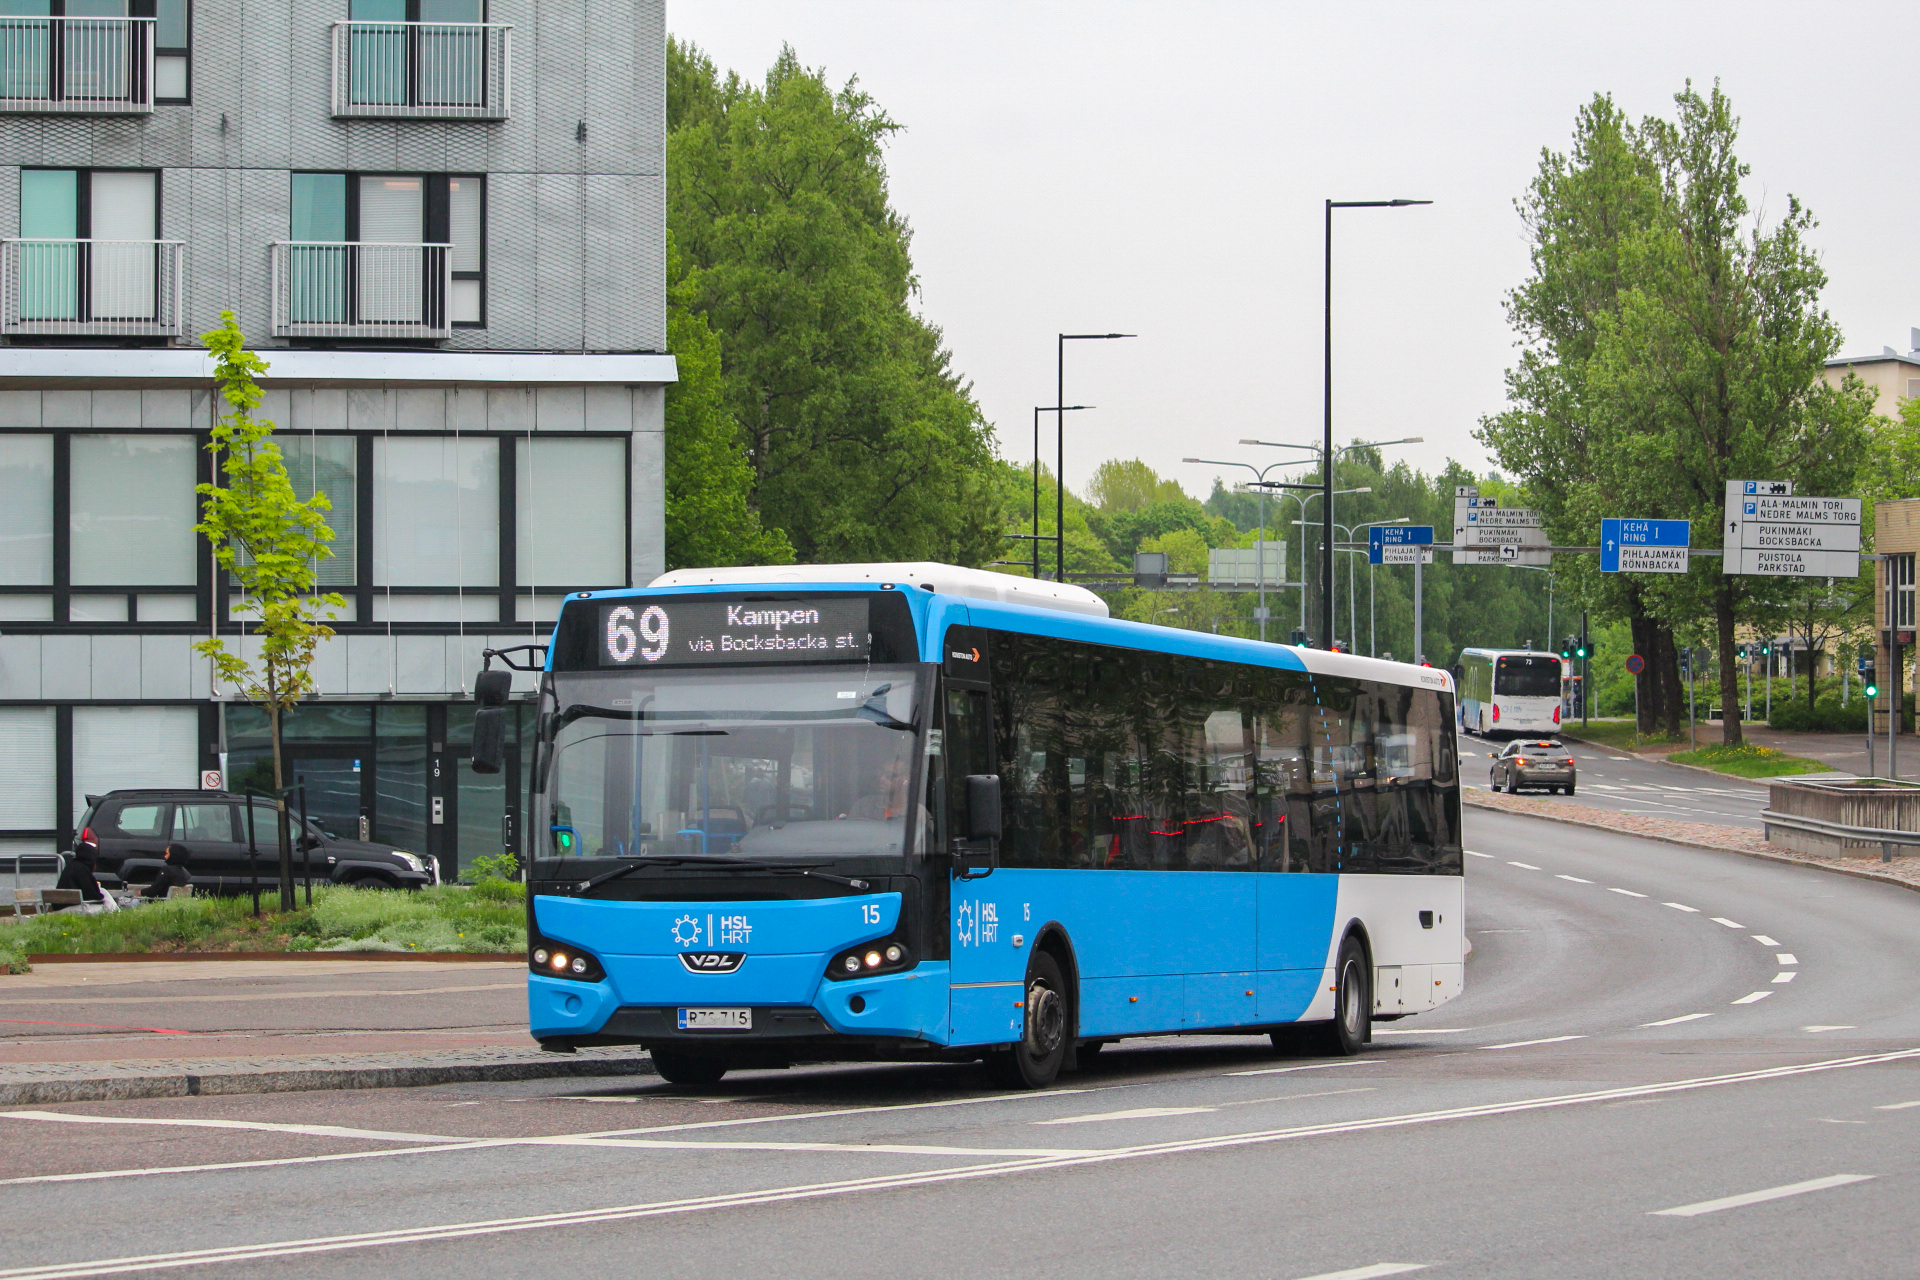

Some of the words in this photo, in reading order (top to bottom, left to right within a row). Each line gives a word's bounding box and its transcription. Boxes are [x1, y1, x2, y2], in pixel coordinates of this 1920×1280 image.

[1760, 500, 1818, 509] ALA-MALMIN
[1823, 501, 1843, 510] TORI
[1760, 510, 1791, 519] NEDRE
[1796, 511, 1828, 520] MALMS
[1833, 512, 1857, 520] TORG
[1623, 522, 1649, 532] KEHÄ
[1759, 526, 1812, 536] PUKINMÄKI
[1623, 533, 1646, 542] RING
[1759, 537, 1822, 547] BOCKSBACKA
[1622, 549, 1685, 559] PIHLAJAMÄKI
[1758, 553, 1802, 562] PUISTOLA
[1622, 559, 1680, 569] RÖNNBACKA
[1758, 563, 1805, 573] PARKSTAD
[607, 605, 669, 662] 69
[727, 605, 819, 631] Kampen
[688, 636, 714, 651] via
[721, 634, 829, 651] Bocksbacka
[835, 633, 859, 649] st.
[862, 904, 880, 924] 15
[982, 903, 999, 922] HSL
[1023, 903, 1030, 921] 15
[721, 915, 753, 929] HSL
[721, 929, 753, 944] HRT
[982, 923, 999, 942] HRT
[689, 955, 734, 967] VDL
